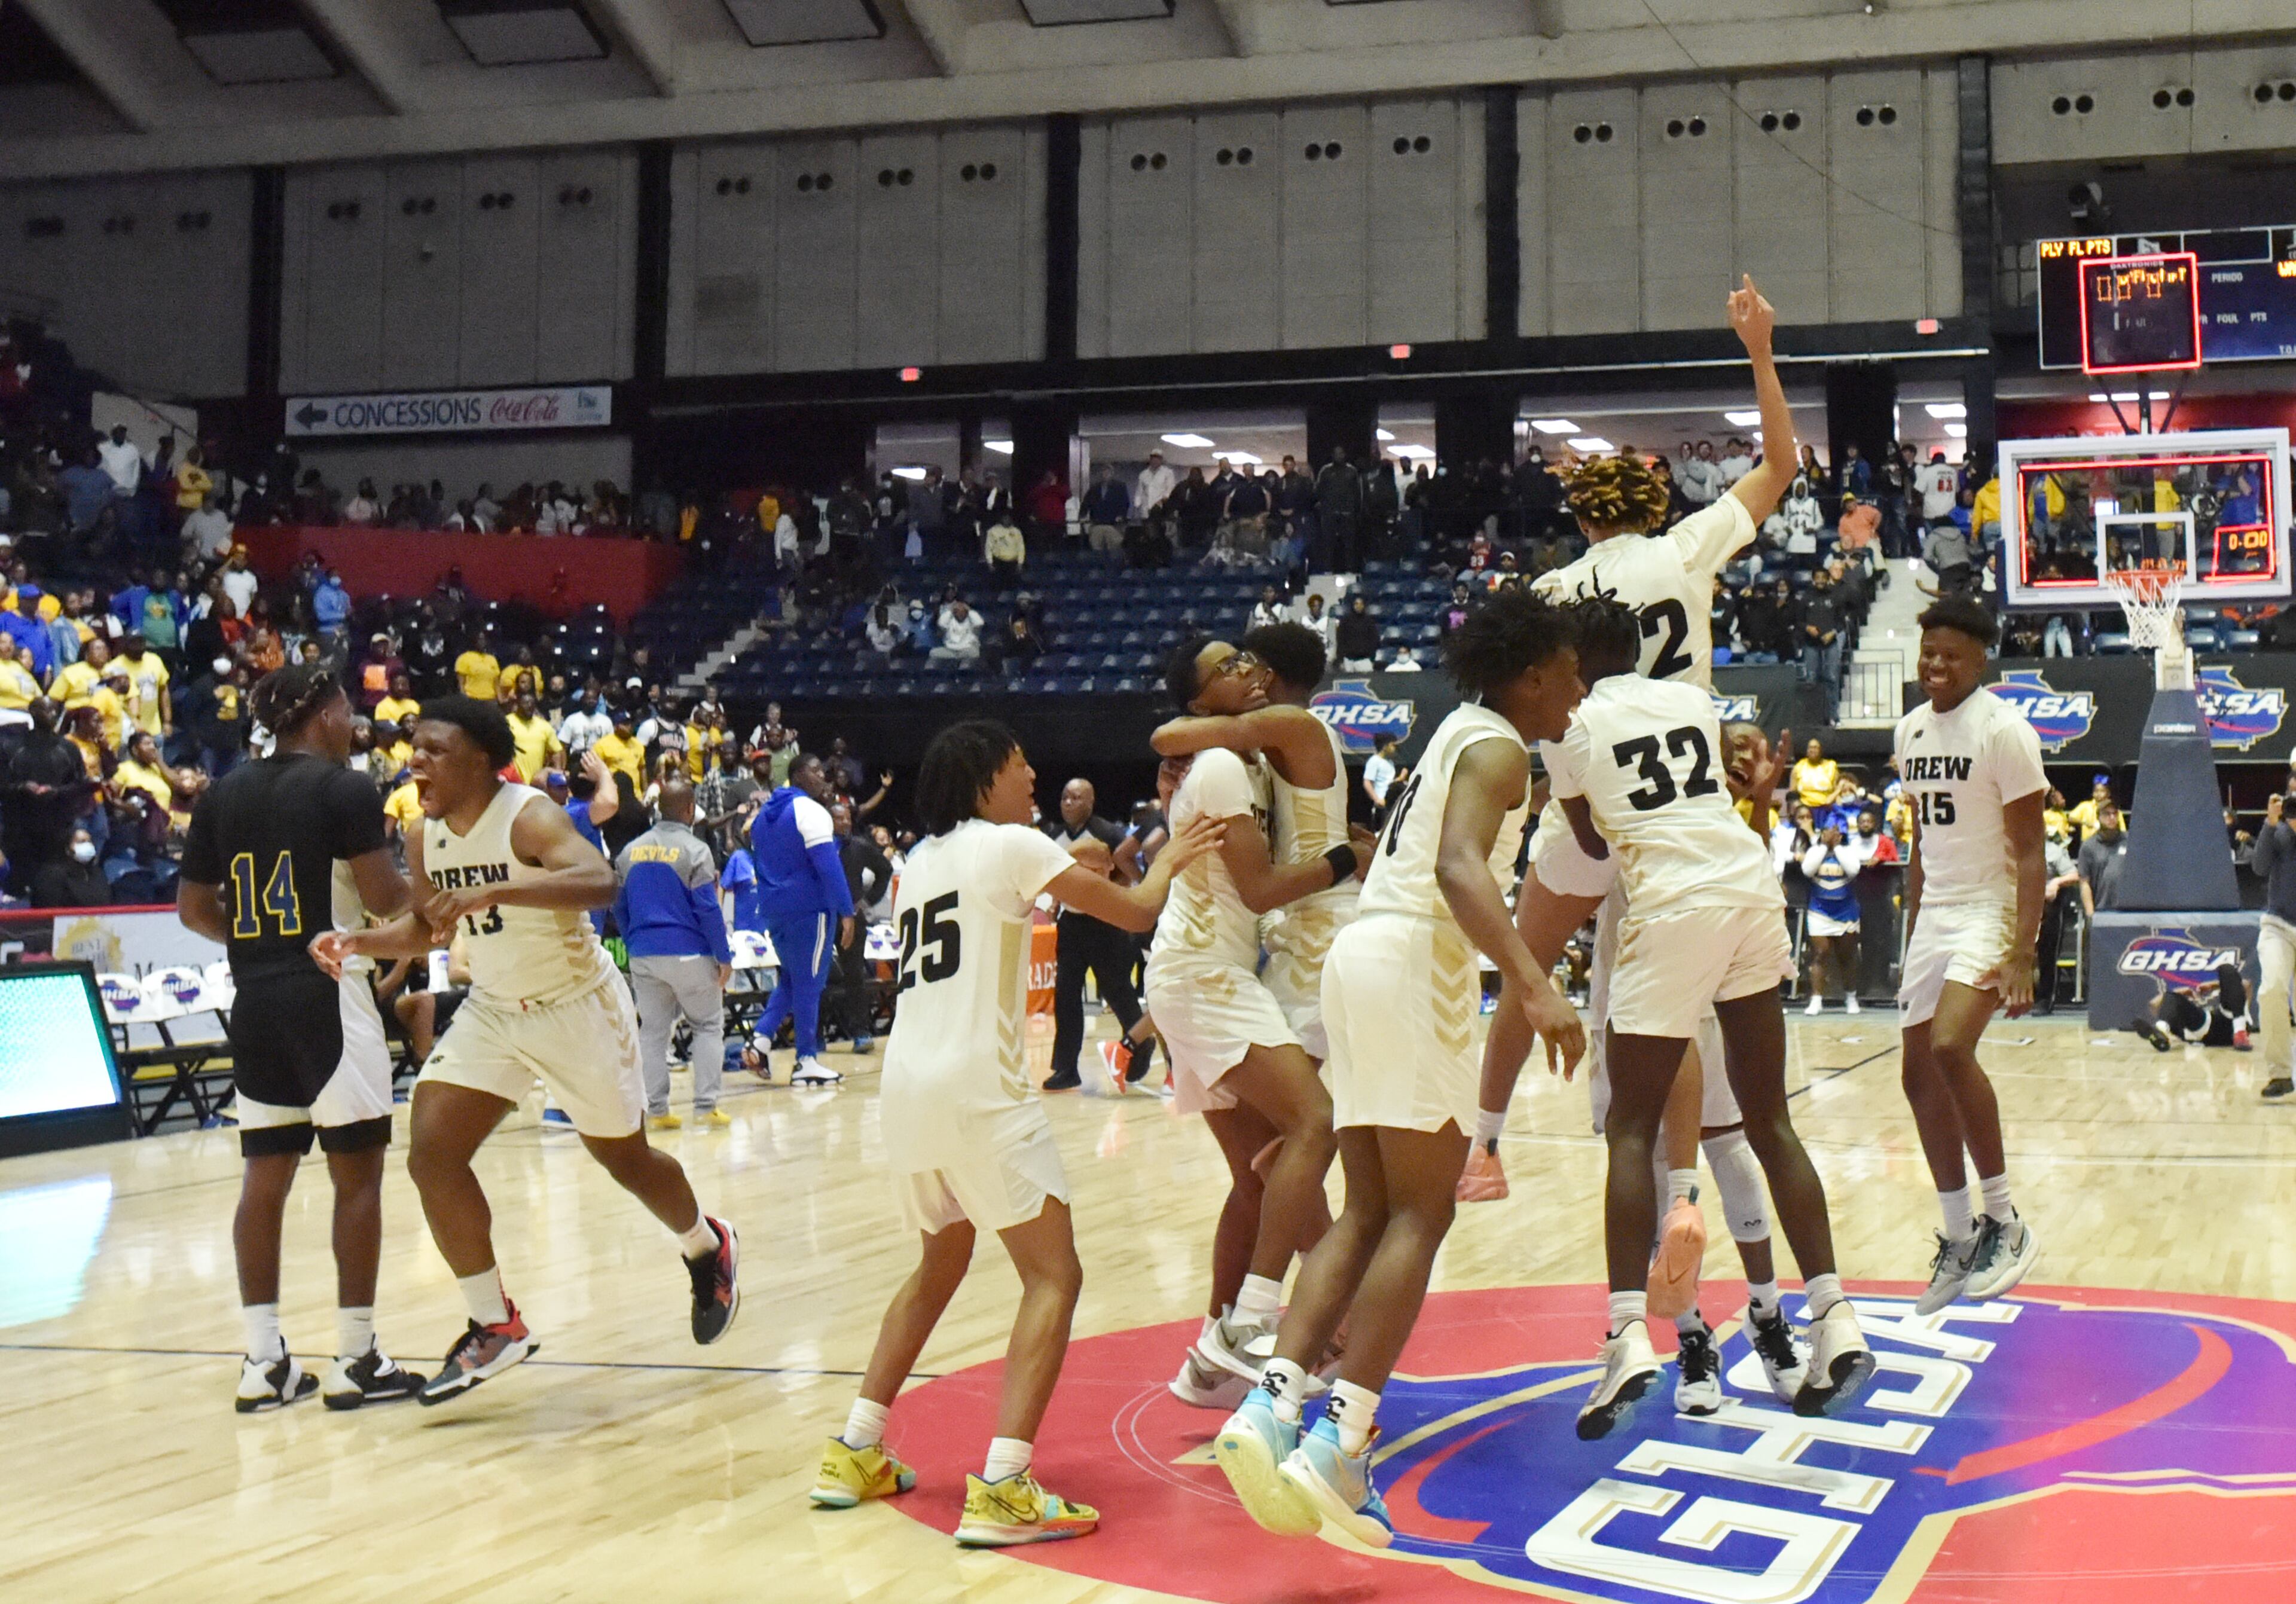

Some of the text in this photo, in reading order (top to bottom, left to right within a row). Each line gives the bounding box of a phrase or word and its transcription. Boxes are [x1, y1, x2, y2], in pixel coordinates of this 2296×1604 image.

[2041, 239, 2111, 257] PLY FL PTS
[2211, 271, 2243, 283] PERIOD
[2216, 313, 2239, 324] FOUL
[2250, 311, 2267, 322] PTS
[334, 398, 482, 428] CONCESSIONS
[2005, 696, 2090, 718] HSA
[1613, 726, 1718, 811] 32
[1905, 756, 1973, 782] DREW
[1921, 792, 1956, 825] 15
[630, 845, 680, 863] DEVILS
[431, 863, 509, 891] DREW
[231, 850, 301, 939] 14
[465, 903, 503, 936] 13
[897, 889, 961, 995] 25
[2121, 951, 2236, 971] GHSA
[1525, 1299, 2023, 1602] GHSA
